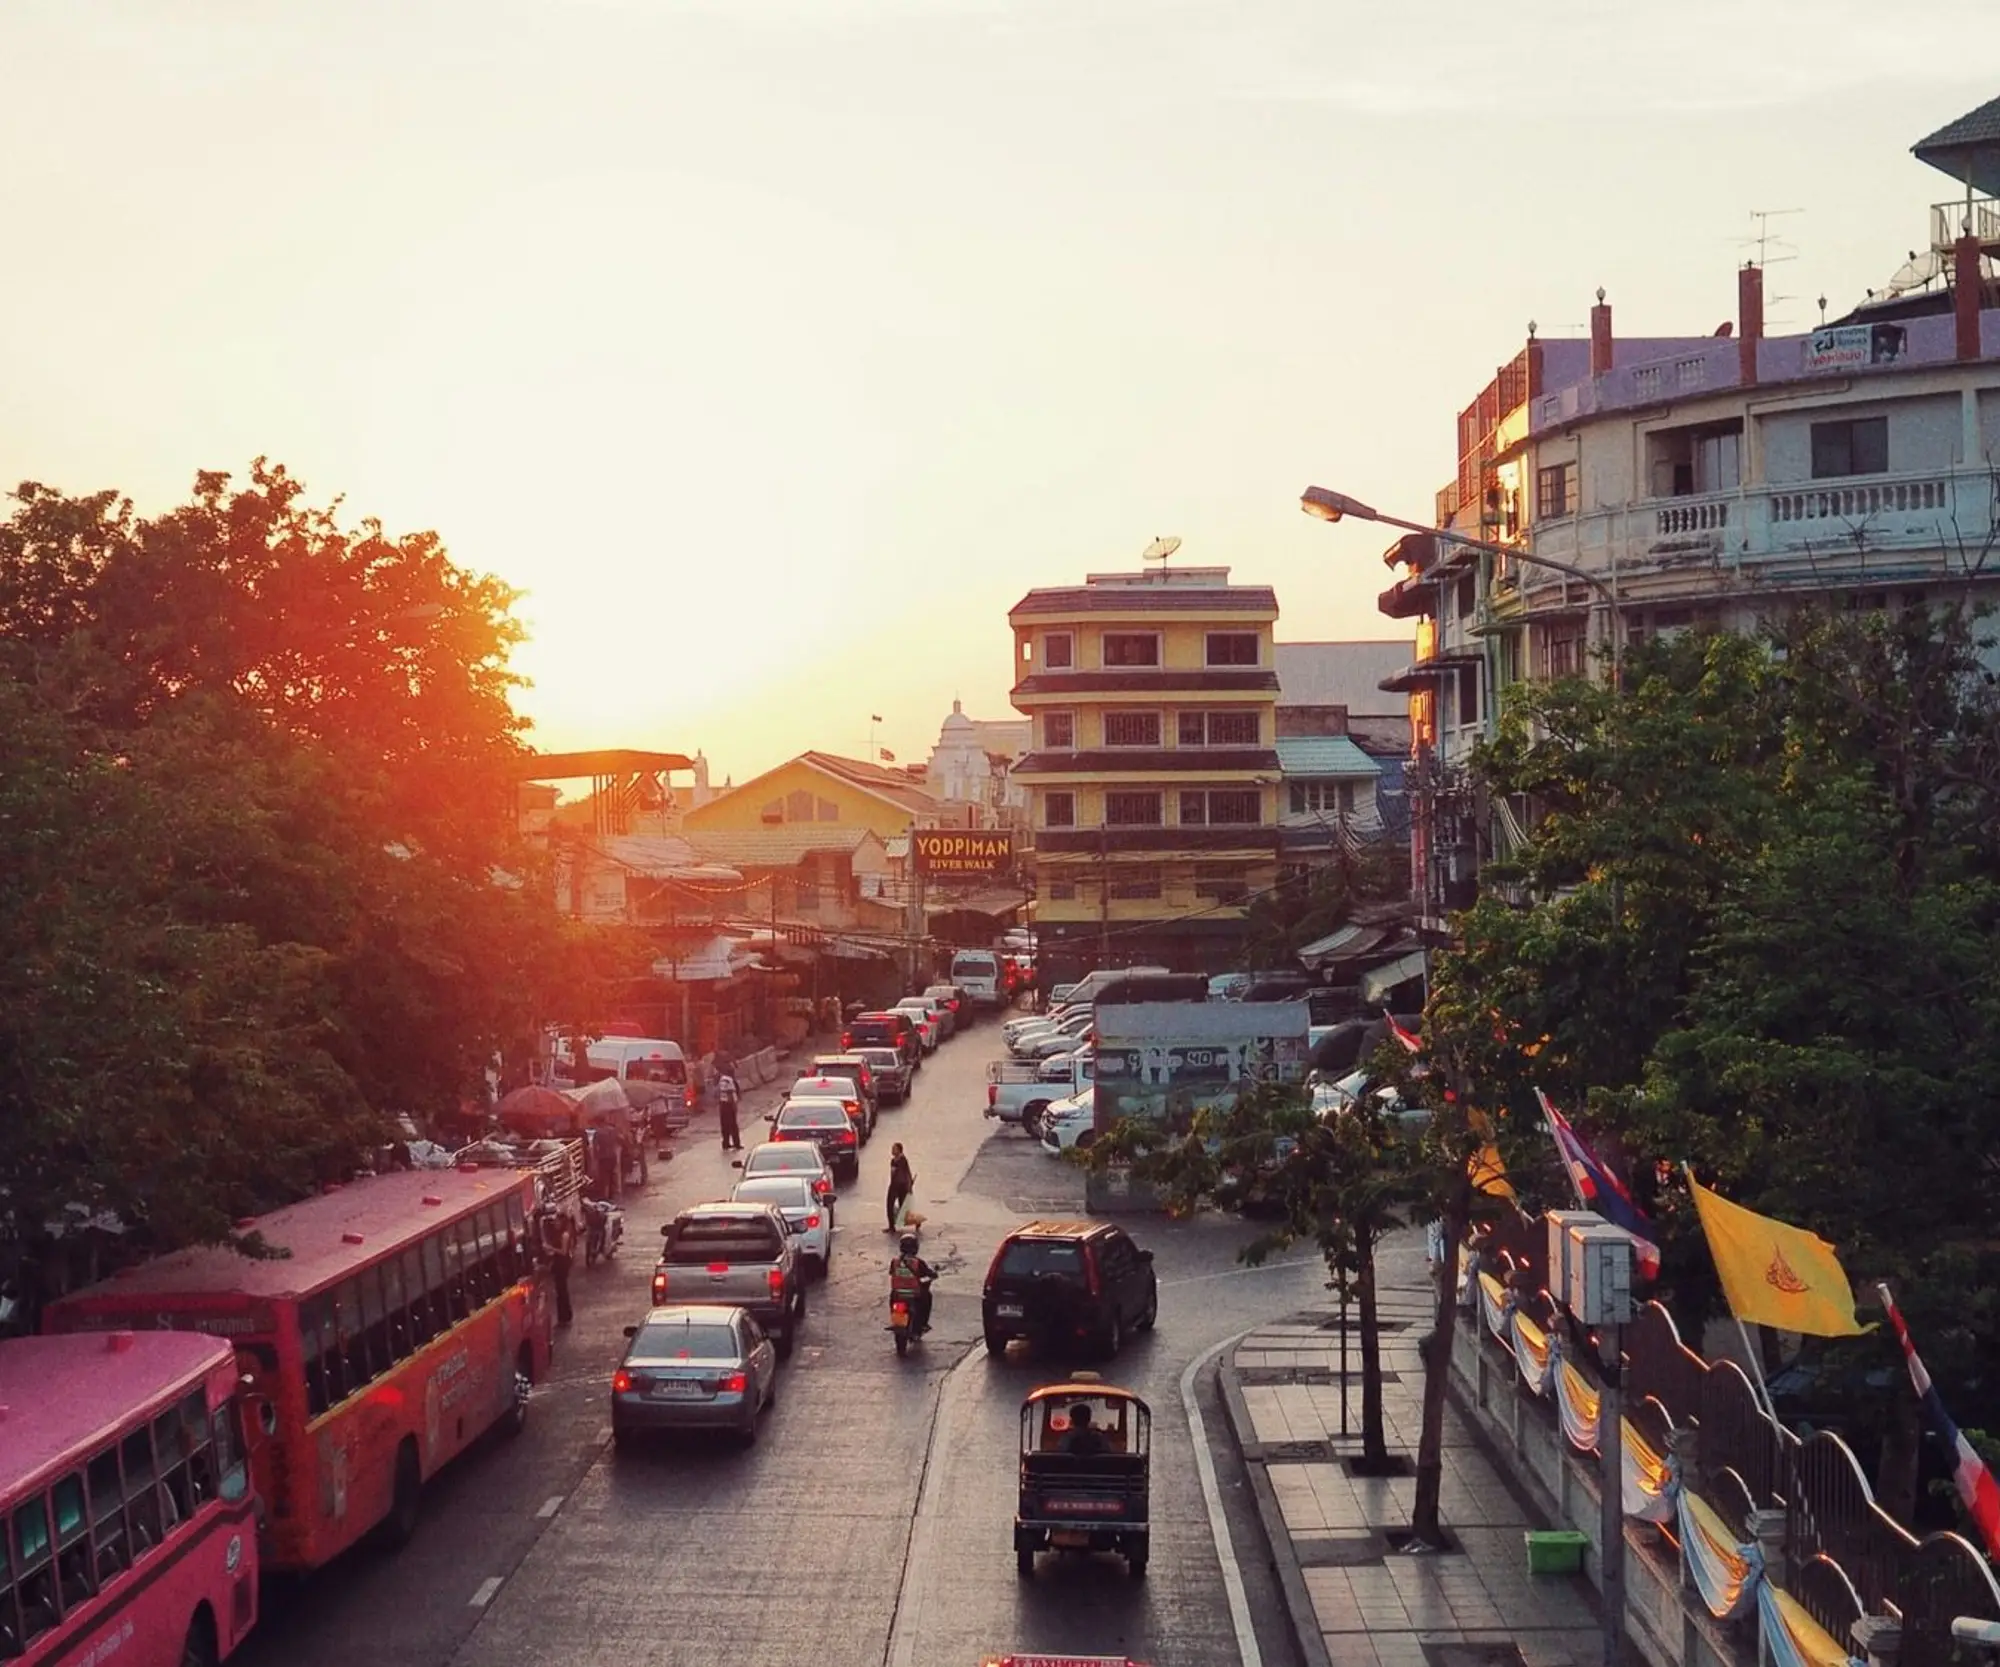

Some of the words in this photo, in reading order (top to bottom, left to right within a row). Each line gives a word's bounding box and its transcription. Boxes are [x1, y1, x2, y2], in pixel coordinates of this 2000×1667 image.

[917, 837, 1009, 856] YODPIMAN
[929, 859, 962, 869] RIVER
[965, 859, 995, 869] WALK
[1188, 1052, 1212, 1066] 40
